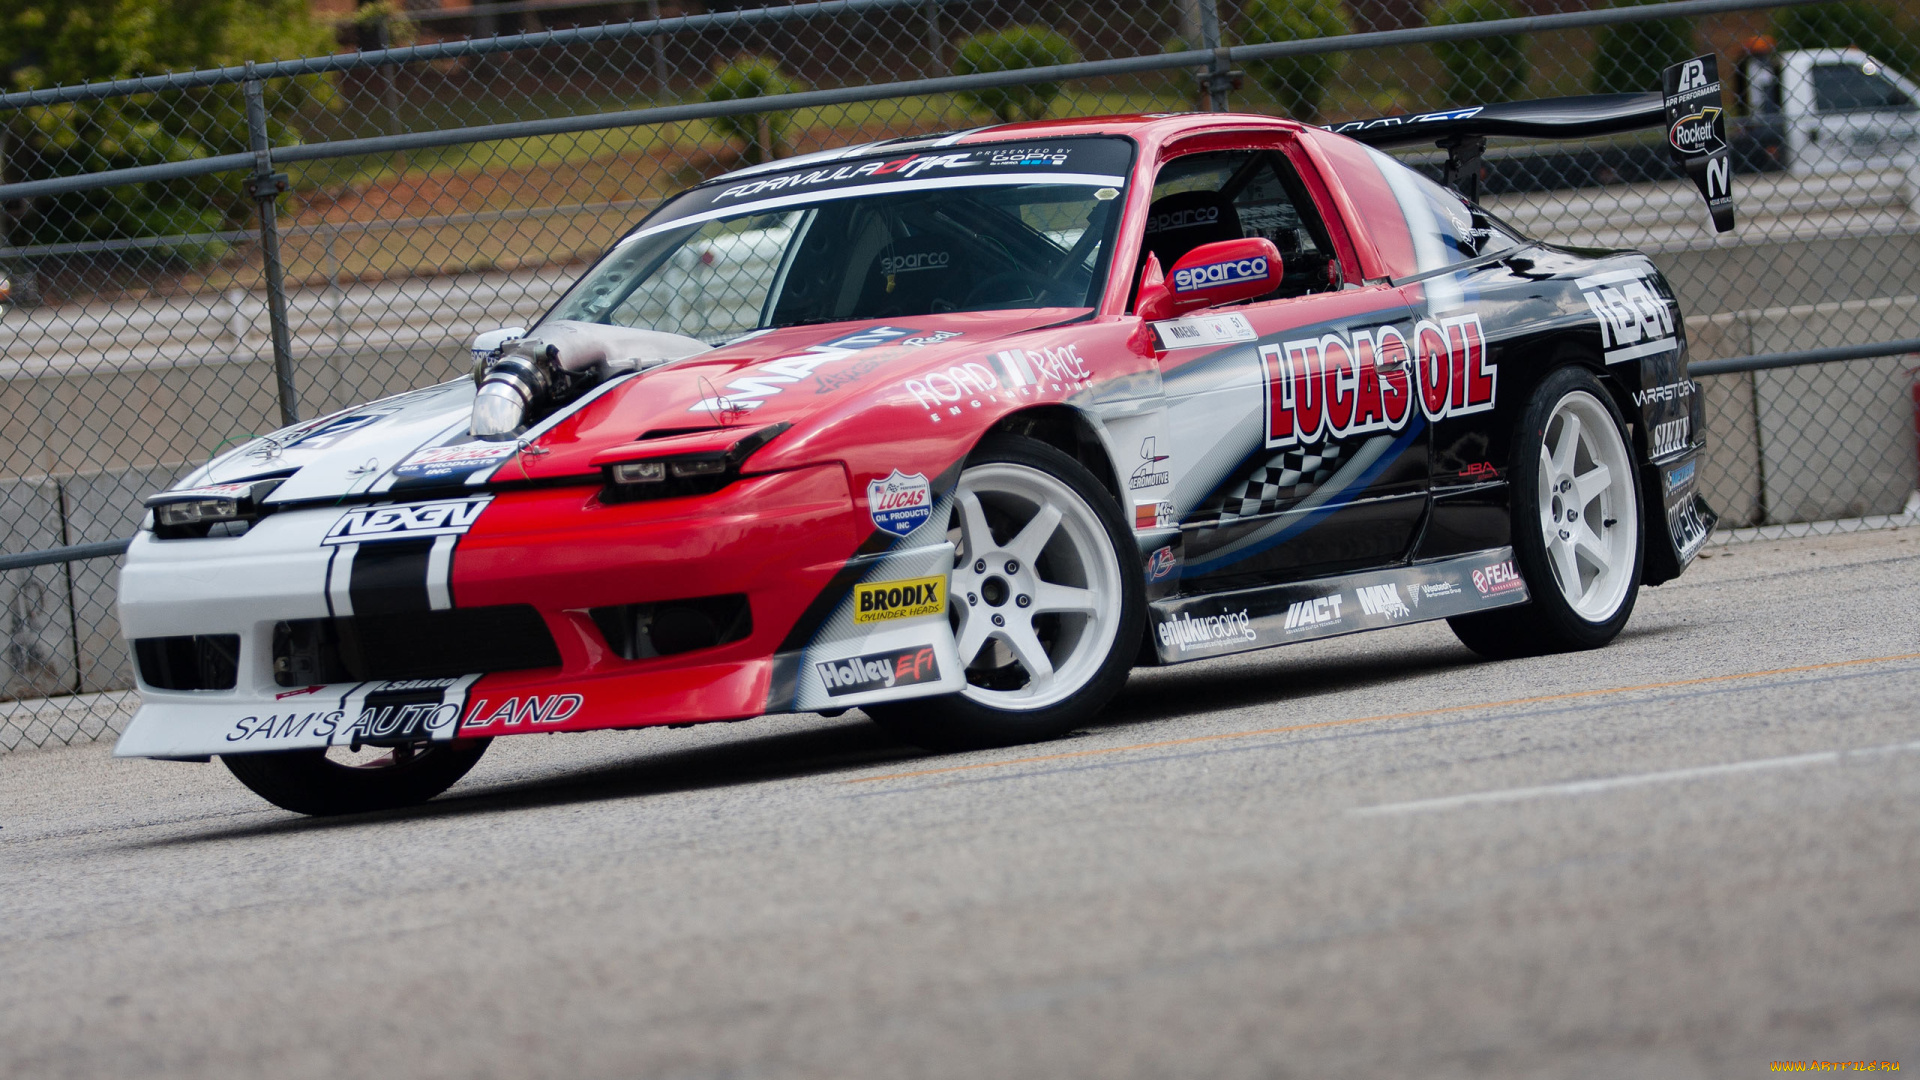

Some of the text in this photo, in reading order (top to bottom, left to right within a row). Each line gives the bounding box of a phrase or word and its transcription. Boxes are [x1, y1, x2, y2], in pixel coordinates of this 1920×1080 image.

[1665, 85, 1721, 107] APR PERFORMANCE
[1676, 121, 1712, 145] Rockett
[976, 148, 1050, 156] PRESENTED
[991, 153, 1068, 162] GoPro
[1147, 206, 1219, 231] sparco
[881, 252, 950, 274] sparco
[1175, 258, 1267, 290] sparco
[1170, 316, 1244, 339] MAENG 51
[905, 344, 1090, 410] ROAD RACE
[1259, 313, 1497, 449] LUCAS OIL
[930, 379, 1094, 423] ENGINEERING
[1653, 416, 1690, 457] SIKKY
[397, 458, 498, 473] OIL PRODUCTS
[1458, 461, 1498, 477] JBA
[1129, 471, 1169, 490] AEROMOTIVE
[878, 489, 926, 510] LUCAS
[326, 500, 494, 538] NEXEN
[875, 508, 929, 522] OIL PRODUCTS
[1485, 561, 1519, 585] FEAL
[860, 582, 938, 612] BRODIX
[1356, 583, 1402, 615] MAX
[860, 604, 939, 622] CYLINDER HEADS
[817, 658, 896, 688] Holley
[226, 694, 584, 742] SAM'S AUTO LAND
